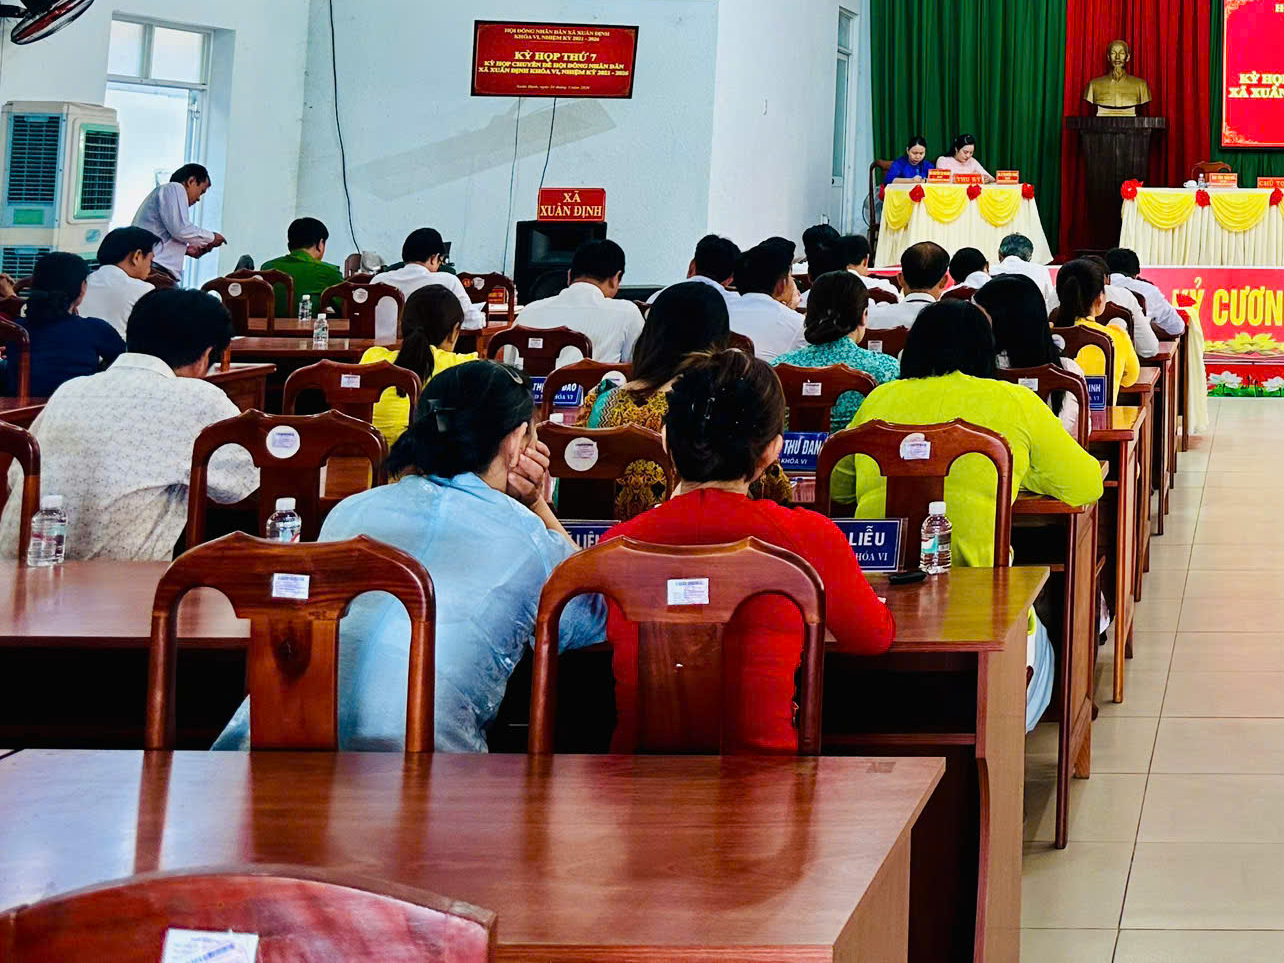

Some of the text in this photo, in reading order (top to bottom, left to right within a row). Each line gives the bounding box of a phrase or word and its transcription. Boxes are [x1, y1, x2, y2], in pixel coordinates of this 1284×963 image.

[514, 49, 597, 63] KỲ HỌP THỨ 7
[1239, 70, 1260, 87] KỲ
[1228, 86, 1249, 98] XÃ
[563, 190, 581, 203] XÃ
[540, 203, 602, 218] XUÂN ĐỊNH
[849, 525, 885, 546] LIỄU
[878, 552, 888, 561] VI
